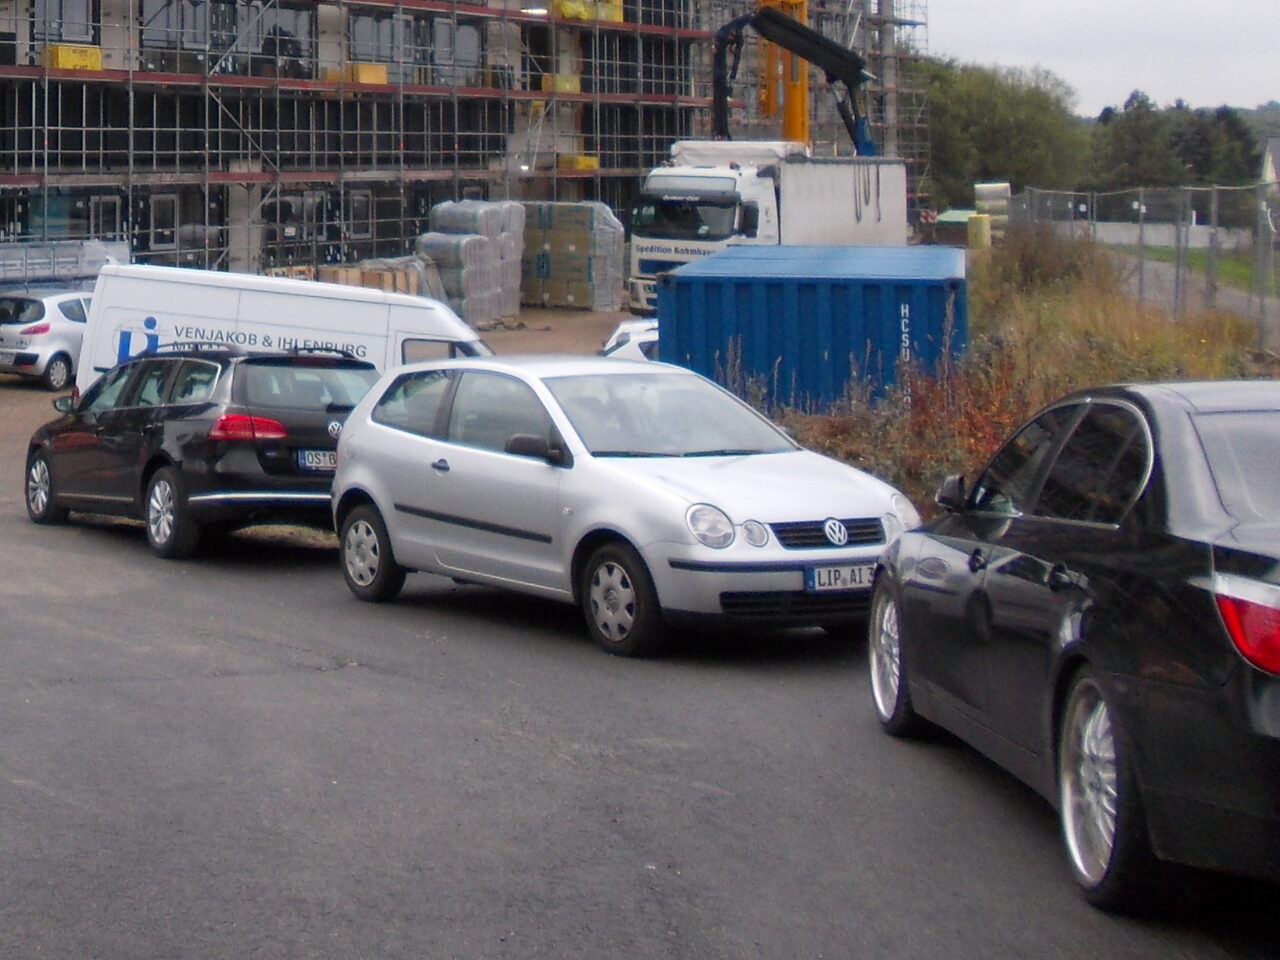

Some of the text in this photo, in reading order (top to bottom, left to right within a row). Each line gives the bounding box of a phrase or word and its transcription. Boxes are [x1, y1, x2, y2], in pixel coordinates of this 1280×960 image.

[636, 245, 672, 254] Spedition
[175, 325, 258, 345] VENJAKOB
[262, 335, 273, 348] &
[901, 304, 910, 361] HCSU
[817, 569, 841, 587] LIP
